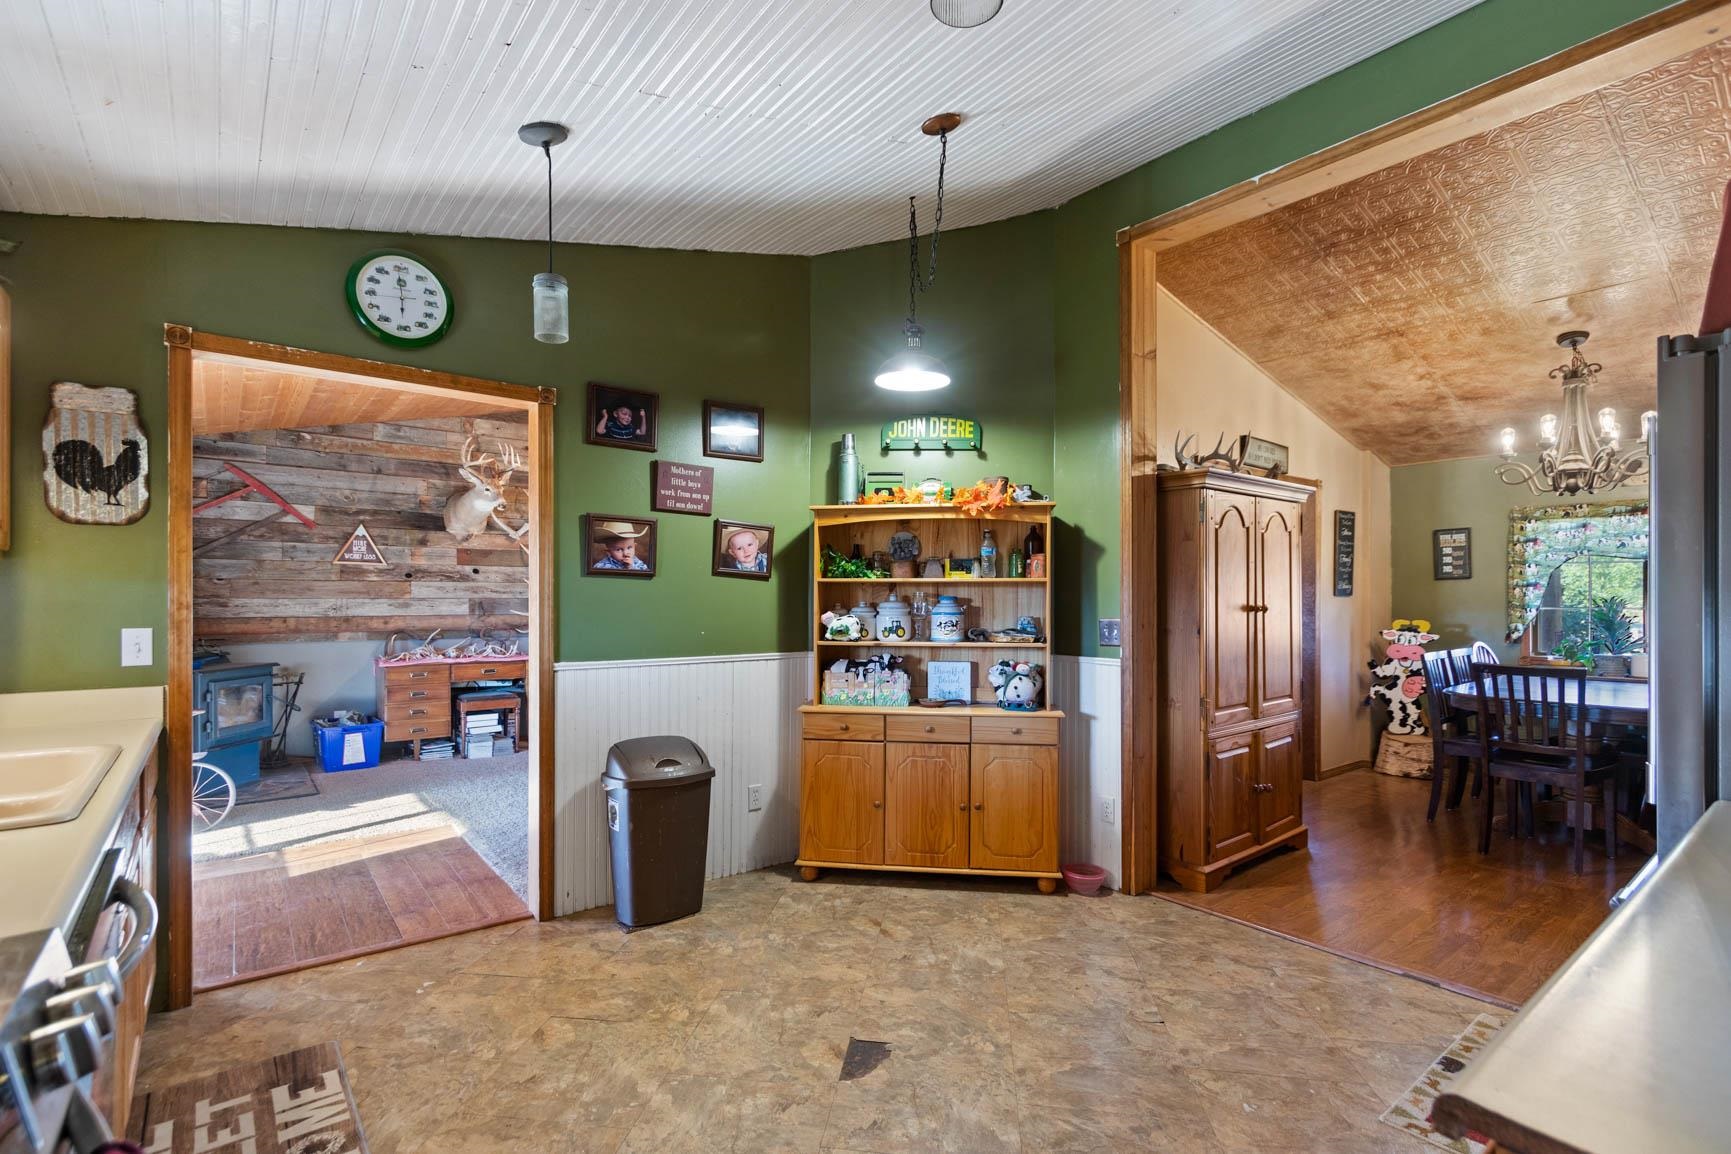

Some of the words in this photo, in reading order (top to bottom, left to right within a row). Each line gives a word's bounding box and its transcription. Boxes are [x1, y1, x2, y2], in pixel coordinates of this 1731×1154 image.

[889, 417, 926, 438] JOHN
[929, 417, 974, 438] DEERE
[671, 466, 695, 476] Mothers
[671, 477, 687, 487] little
[687, 480, 701, 490] boys
[660, 489, 676, 497] work
[677, 490, 691, 498] from
[702, 494, 710, 503] up
